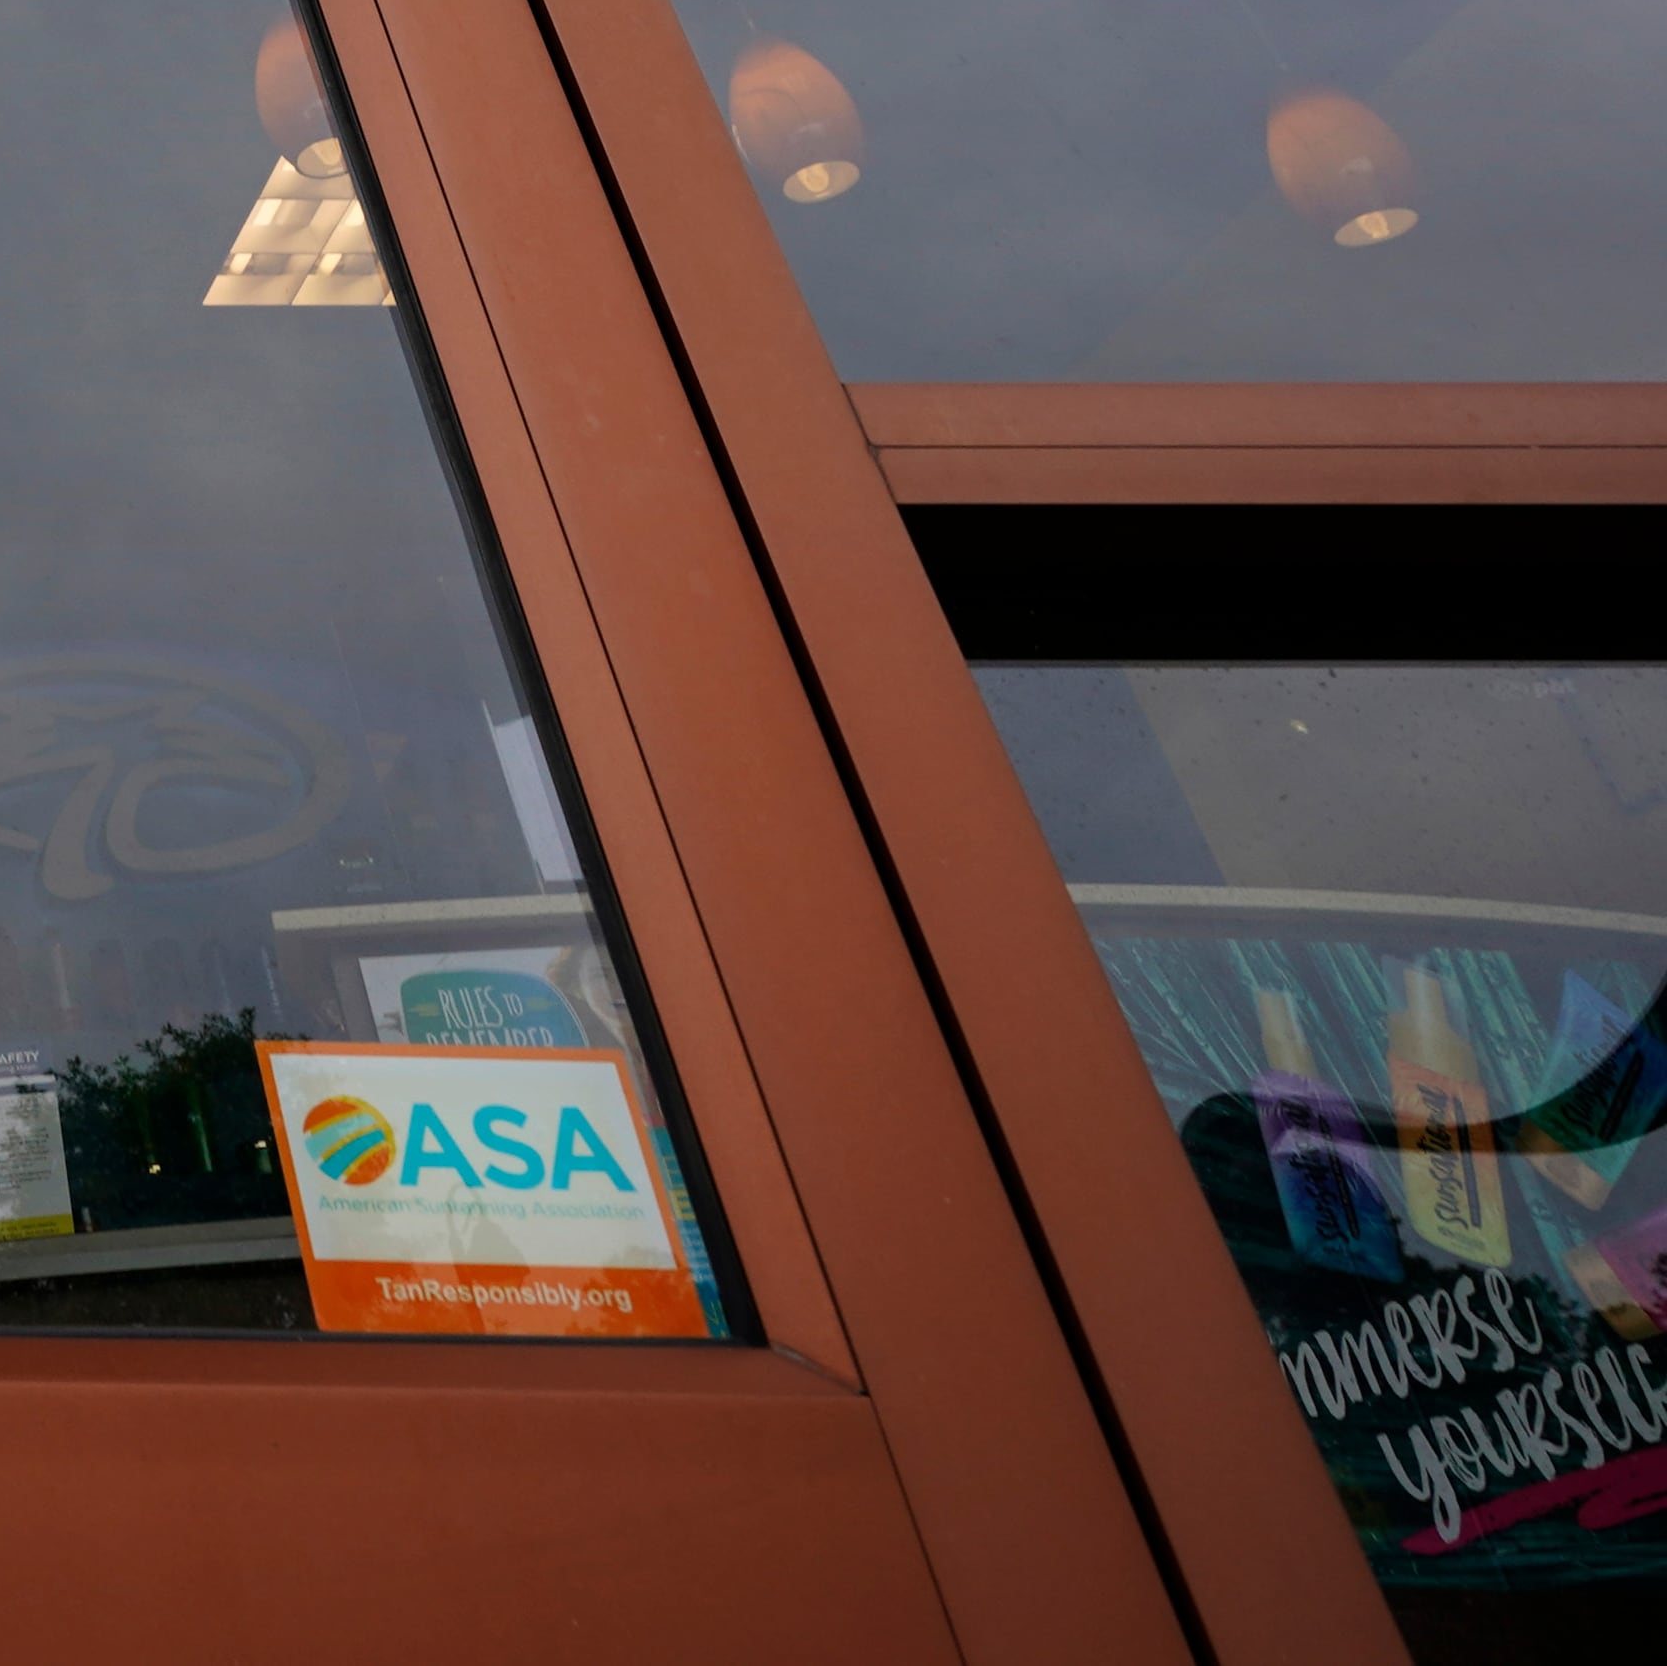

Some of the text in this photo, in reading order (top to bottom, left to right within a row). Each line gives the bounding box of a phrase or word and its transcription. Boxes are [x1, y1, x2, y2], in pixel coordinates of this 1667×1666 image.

[437, 985, 524, 1030] RULES TO
[399, 1102, 639, 1194] ASA
[318, 1195, 647, 1221] American Suntanning Association
[374, 1276, 634, 1314] TanResponsibly.org
